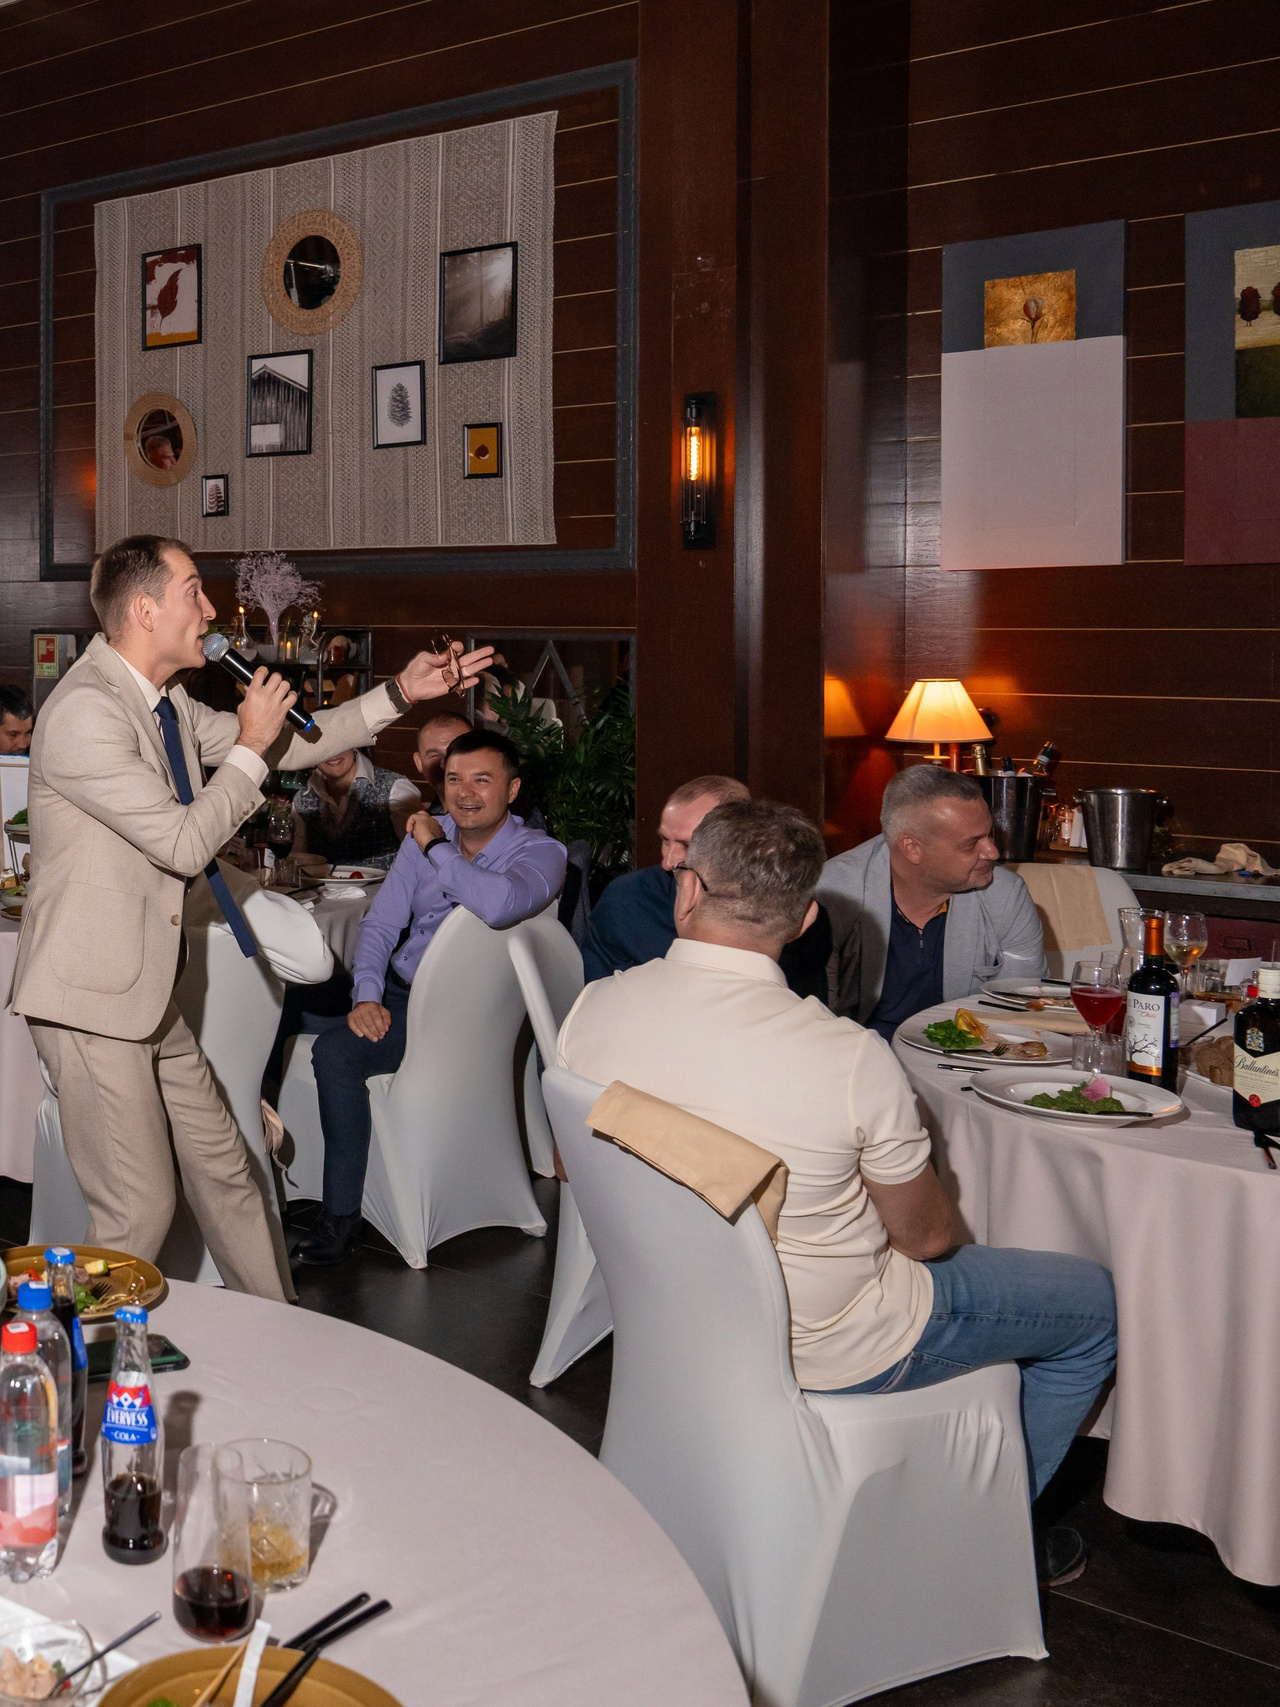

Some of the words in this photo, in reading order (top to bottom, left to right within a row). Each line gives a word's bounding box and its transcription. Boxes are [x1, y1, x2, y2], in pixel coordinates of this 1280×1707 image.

[1133, 998, 1161, 1012] PARO
[1234, 1054, 1279, 1077] Ballantine's
[106, 1406, 149, 1427] EVERVESS
[113, 1430, 137, 1442] COLA
